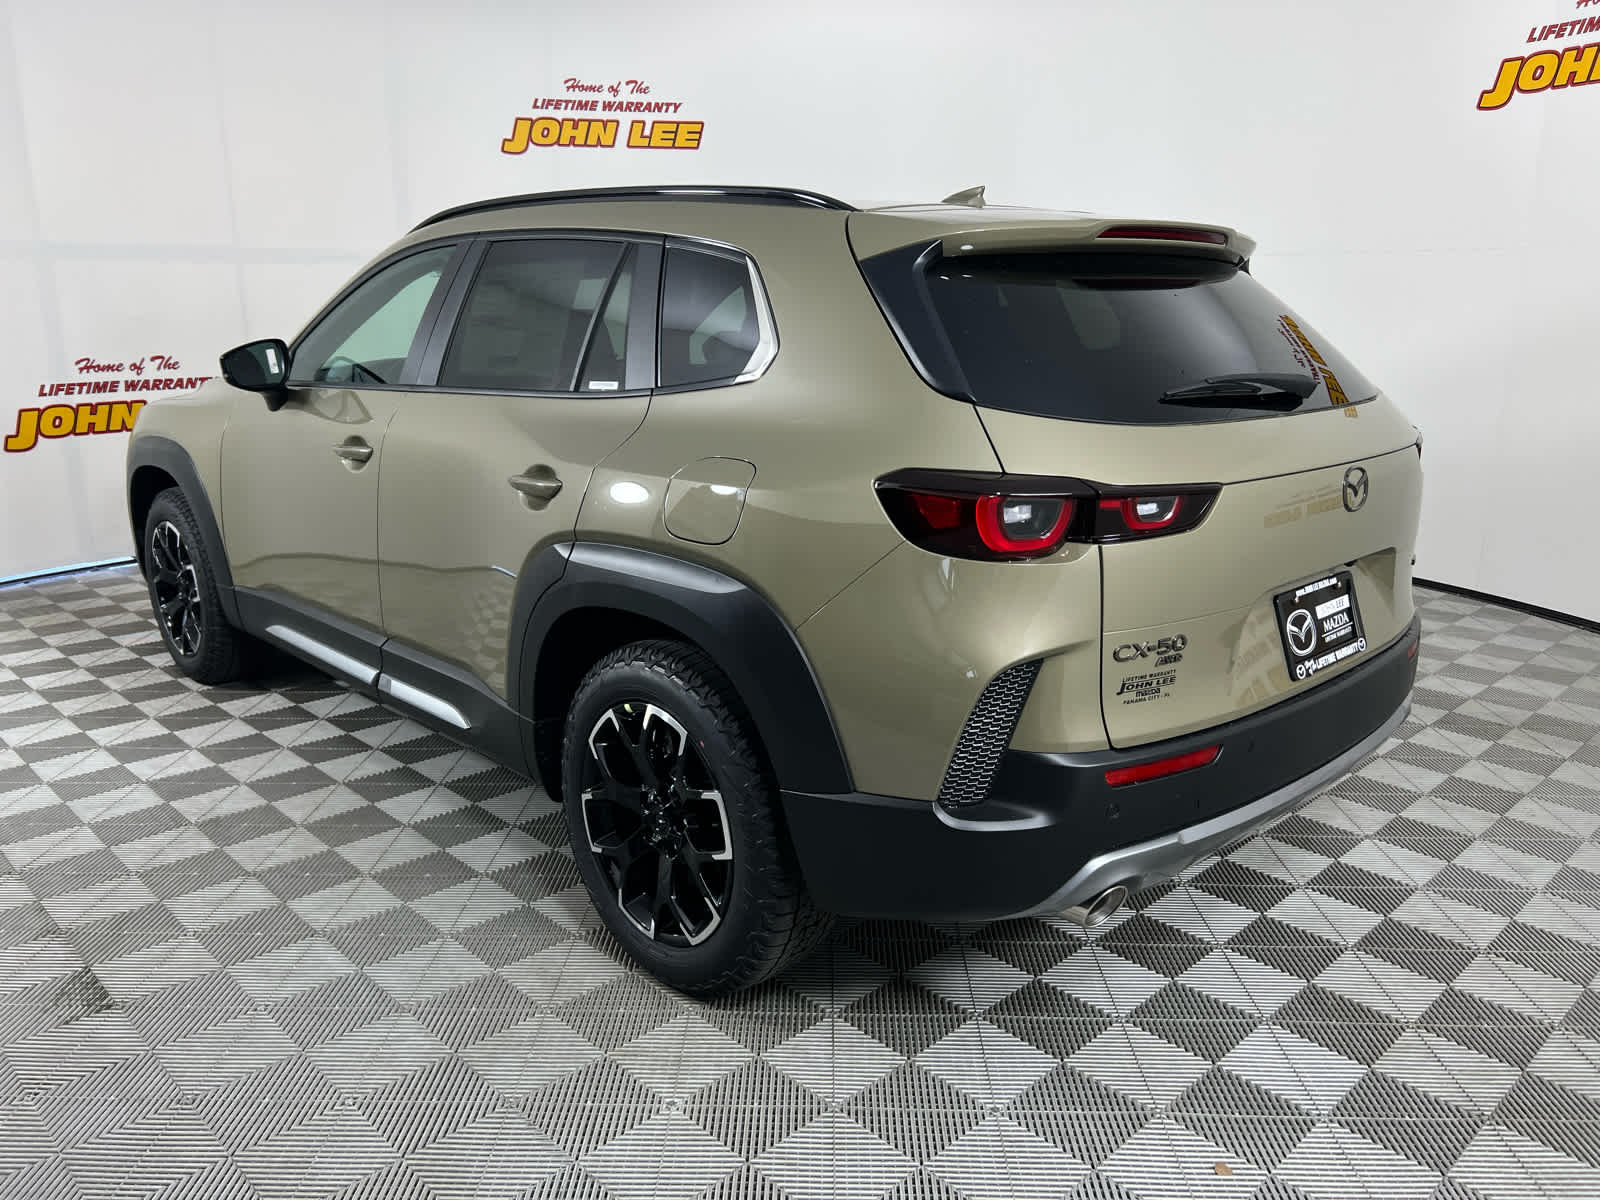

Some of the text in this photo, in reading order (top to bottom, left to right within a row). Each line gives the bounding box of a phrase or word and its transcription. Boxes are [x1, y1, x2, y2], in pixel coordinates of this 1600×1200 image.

[1476, 41, 1600, 111] JOH
[564, 78, 650, 97] Home of The
[532, 98, 682, 113] LIFETIME WARRANTY
[501, 116, 704, 155] JOHN LEE
[75, 355, 180, 376] Home of The
[38, 376, 214, 397] LIFETIME WARRANT
[4, 399, 147, 453] JOHN
[1322, 612, 1350, 632] MAZDA
[1113, 634, 1188, 662] CX-50
[1315, 652, 1337, 669] LIFETIME
[1116, 677, 1176, 696] JOHN LEE
